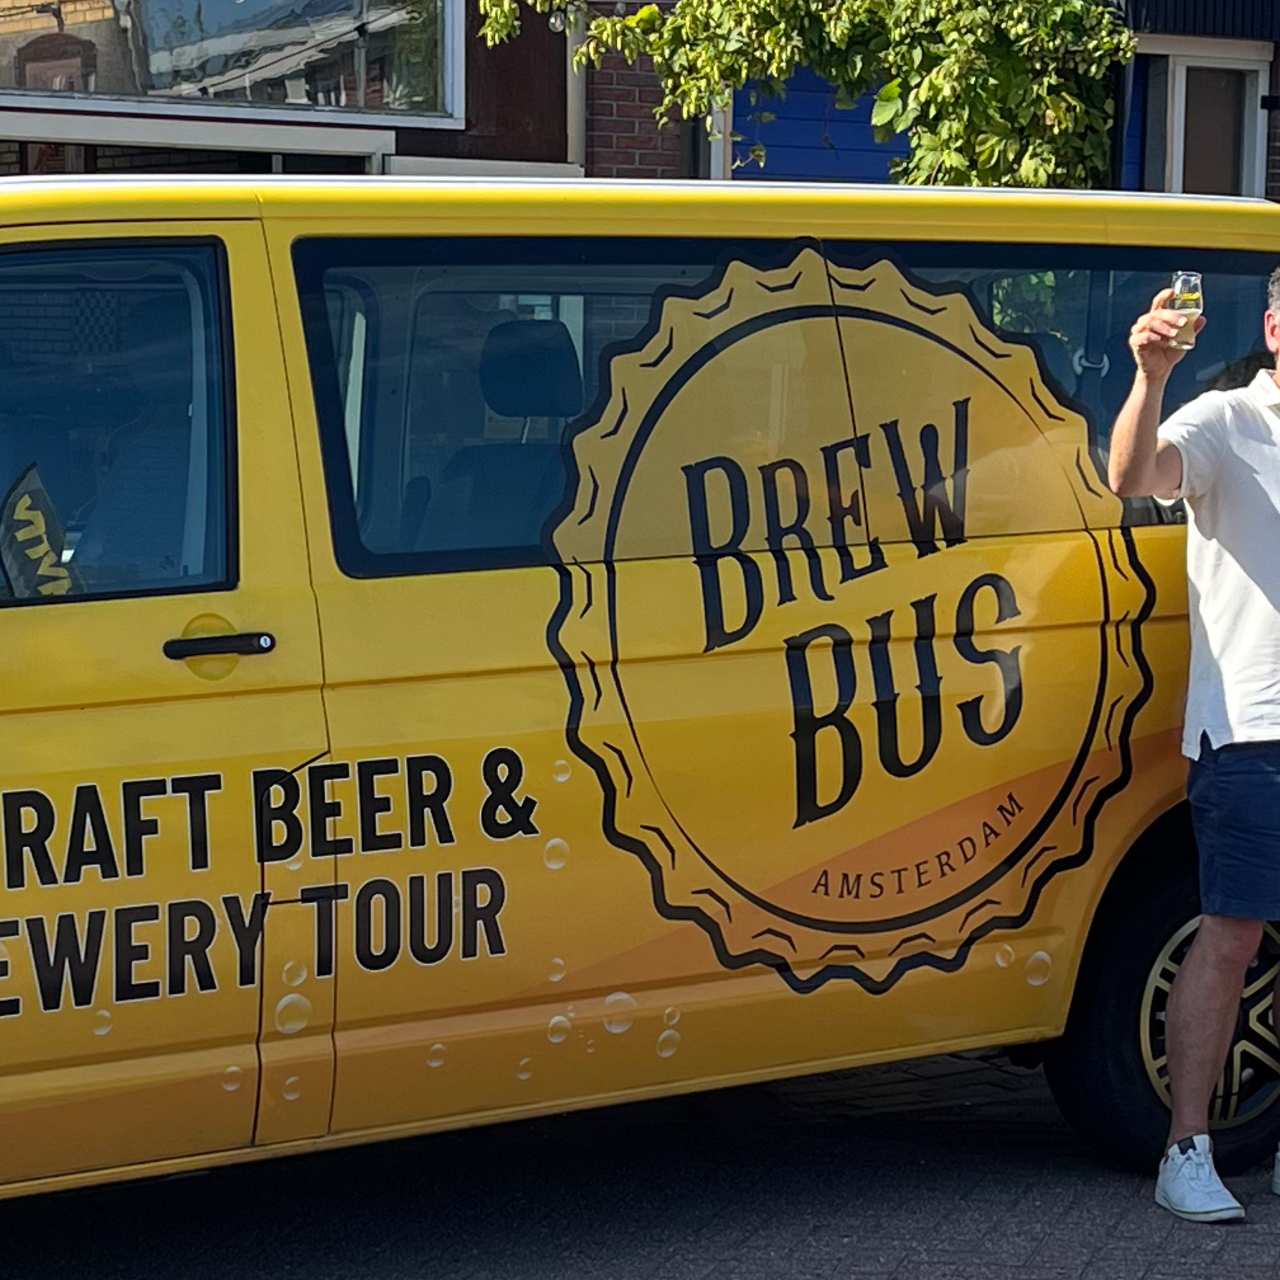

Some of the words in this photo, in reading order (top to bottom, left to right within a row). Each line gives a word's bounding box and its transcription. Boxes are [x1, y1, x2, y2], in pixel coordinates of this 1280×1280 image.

[681, 397, 972, 653] BREW
[783, 572, 1024, 829] BUS
[251, 752, 456, 865] BEER
[479, 746, 542, 842] &
[812, 791, 1024, 900] AMSTERDAM
[300, 867, 508, 982] TOUR
